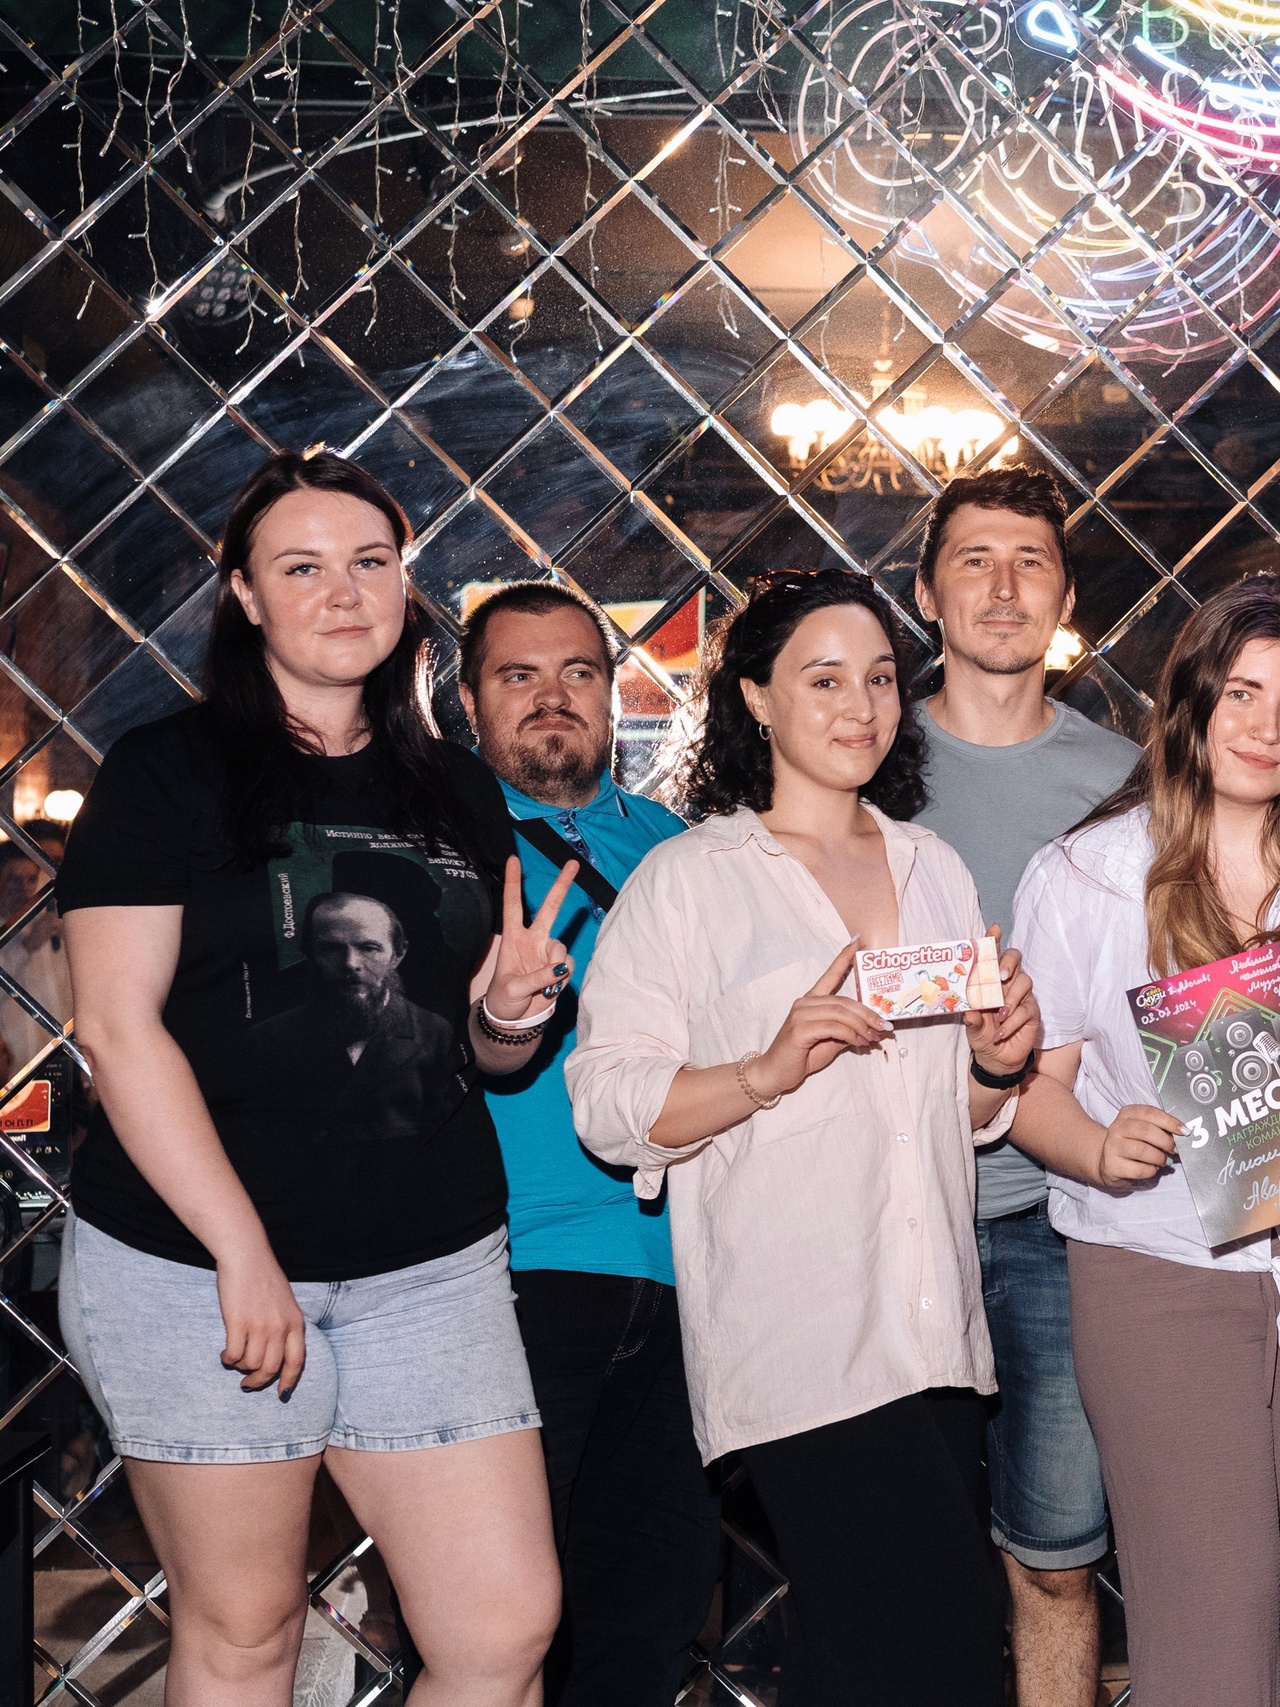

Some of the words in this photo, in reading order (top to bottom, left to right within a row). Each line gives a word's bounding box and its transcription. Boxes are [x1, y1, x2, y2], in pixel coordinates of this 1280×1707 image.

[325, 829, 373, 840] Истинно
[426, 857, 466, 869] велику
[277, 872, 296, 939] Ф.Достоевский
[862, 946, 953, 971] Schogetten
[1136, 991, 1167, 1008] Смузи
[1186, 1116, 1209, 1149] 3
